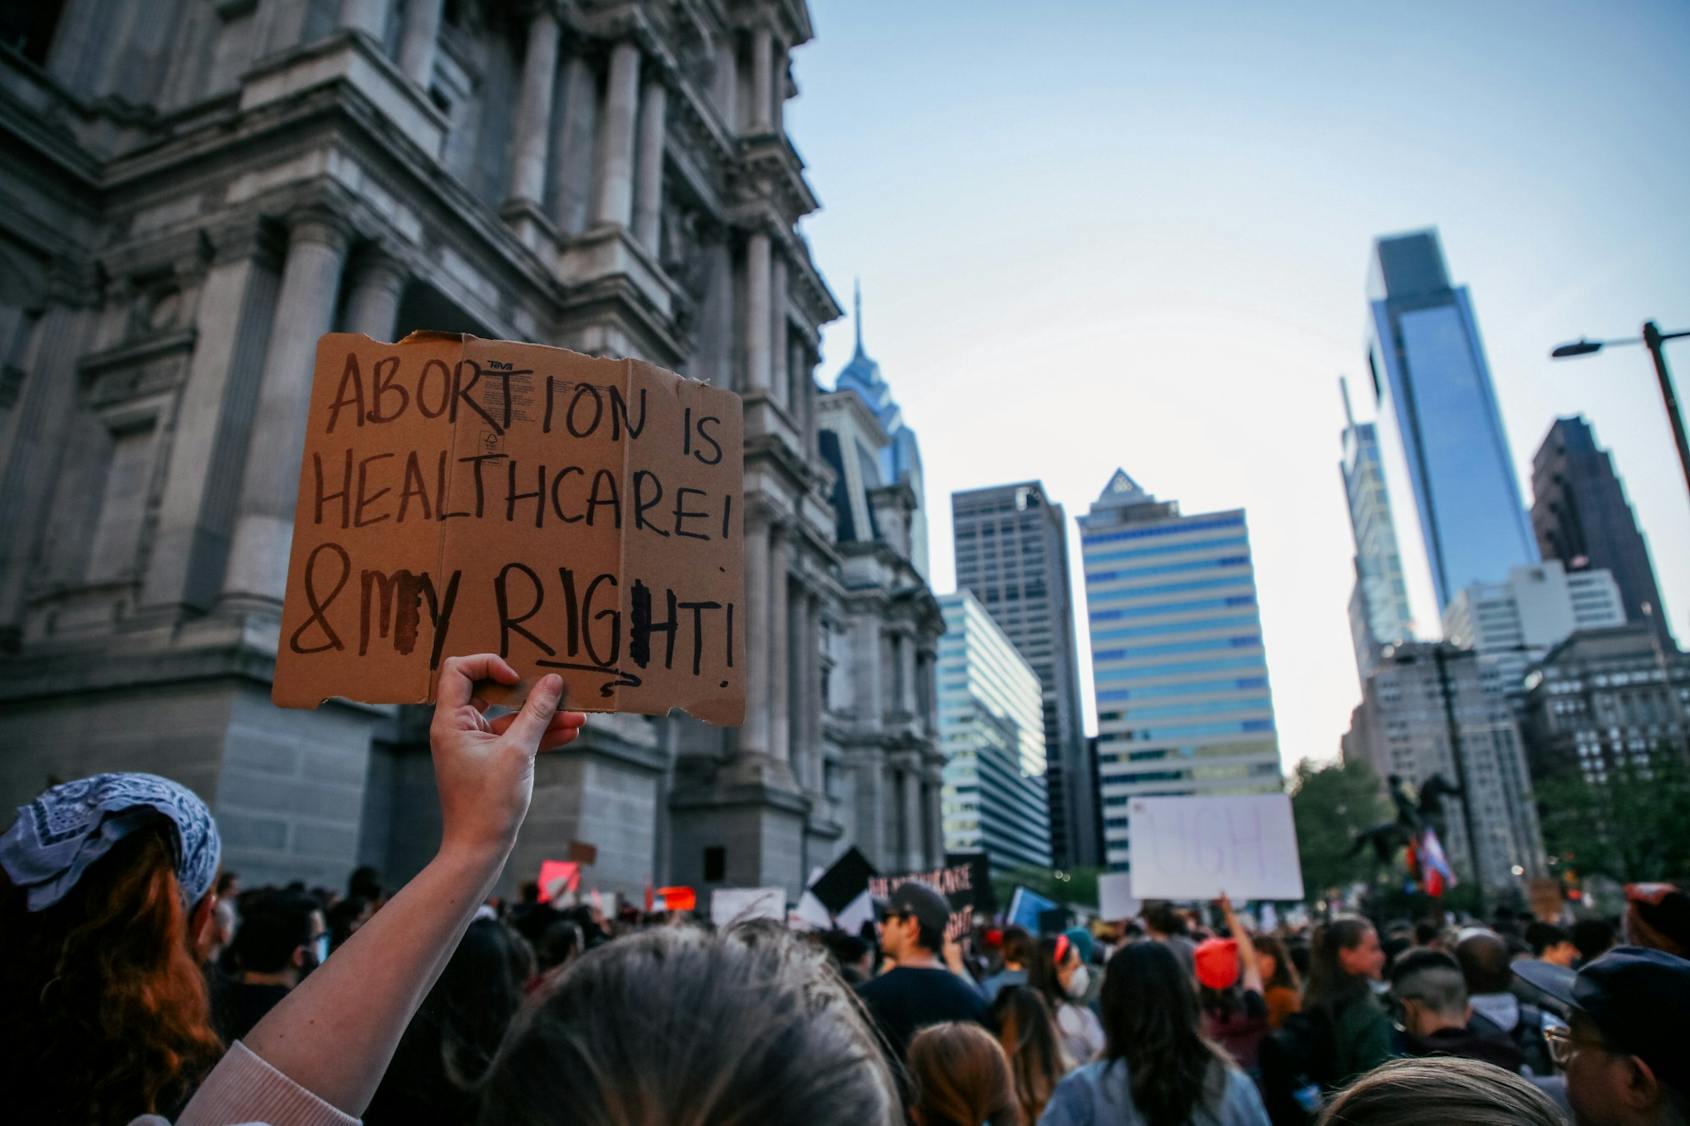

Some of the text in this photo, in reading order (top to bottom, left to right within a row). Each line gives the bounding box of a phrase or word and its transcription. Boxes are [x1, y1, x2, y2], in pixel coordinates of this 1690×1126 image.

[325, 352, 647, 442] ABORTION
[683, 406, 723, 466] IS
[313, 448, 732, 573] HEALTHCARE!
[493, 561, 736, 690] RIGHT!
